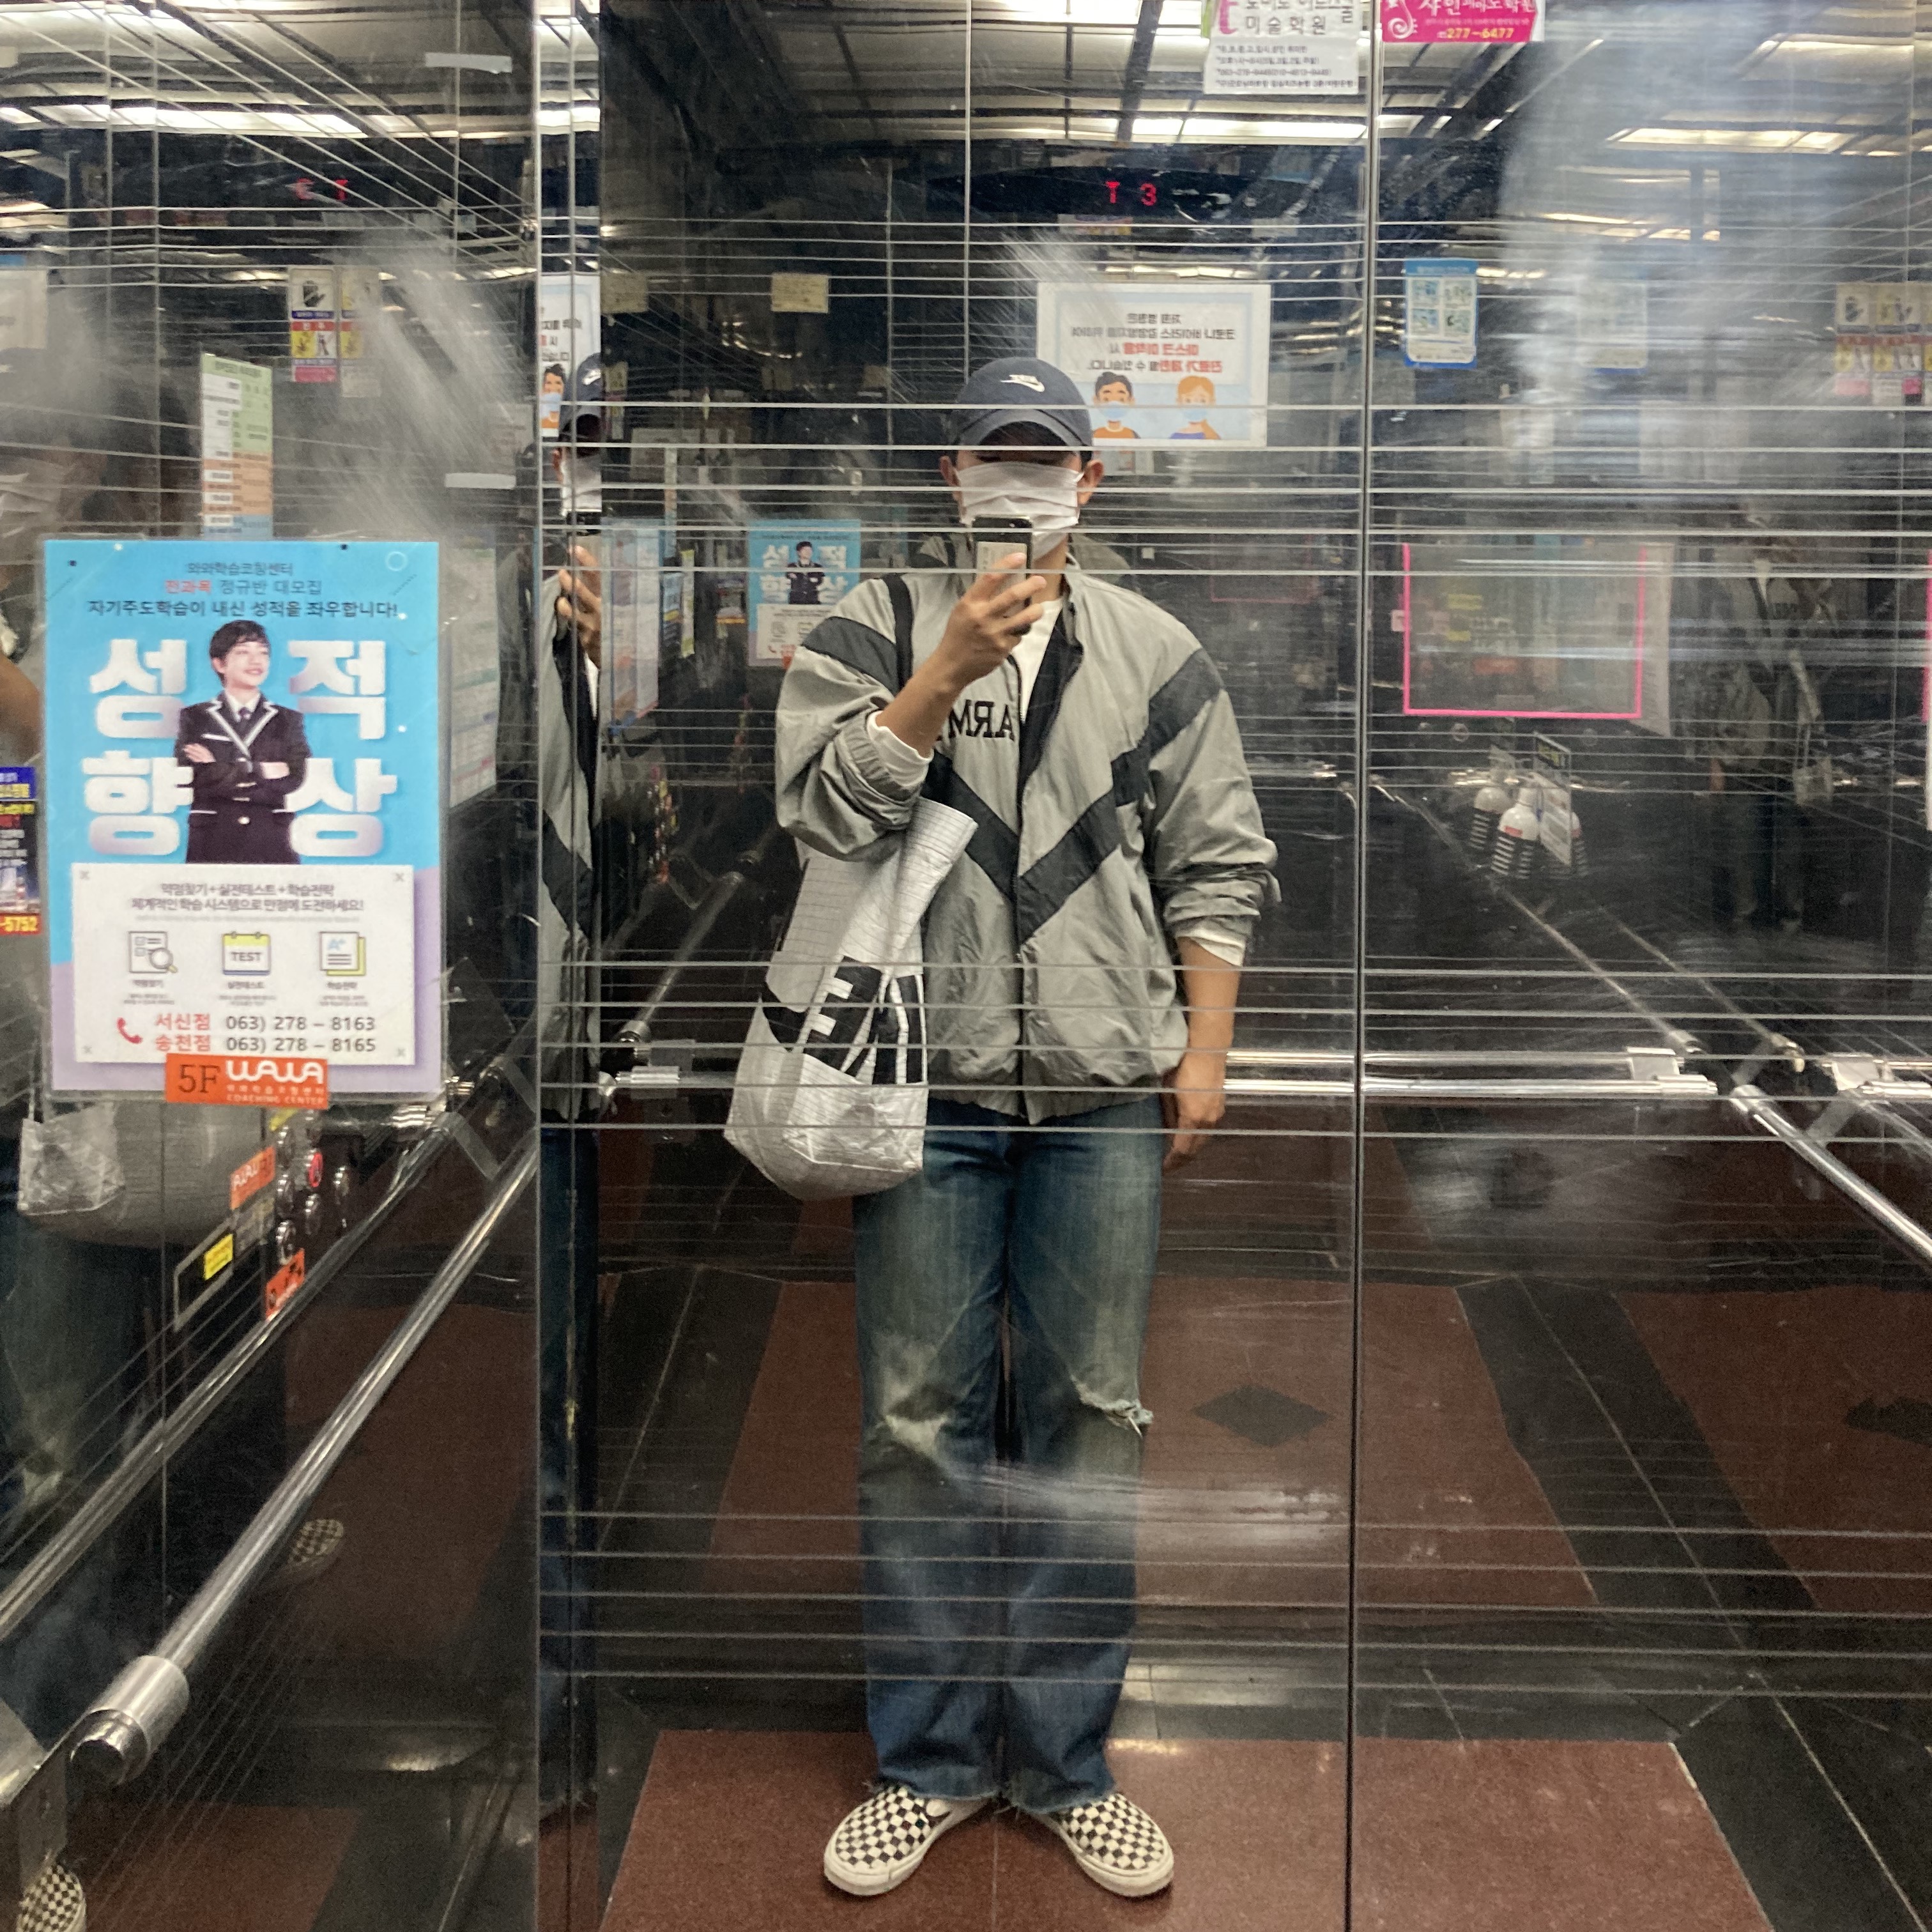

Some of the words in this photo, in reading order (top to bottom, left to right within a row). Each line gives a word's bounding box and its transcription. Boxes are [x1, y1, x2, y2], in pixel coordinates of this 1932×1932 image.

[1245, 15, 1326, 35] 미술학원
[164, 579, 212, 595] 전과목
[220, 579, 269, 595] 정규반
[272, 579, 322, 596] 대모집
[88, 599, 205, 617] 자기주도학습이
[211, 599, 246, 617] 내신
[250, 600, 302, 618] 성적을
[306, 600, 398, 618] 좌우합니다!
[89, 638, 187, 739] 성
[289, 639, 386, 740] 적
[80, 749, 194, 855] 향
[284, 757, 398, 857] 상
[204, 898, 262, 912] 시스템으로
[231, 951, 261, 962] TEST
[155, 1013, 211, 1031] 서신점
[226, 1015, 266, 1032] 063)
[274, 1016, 307, 1030] 278
[331, 1016, 376, 1031] 8163
[155, 1033, 211, 1052] 송천점
[226, 1037, 267, 1054] 063)
[275, 1037, 308, 1052] 278
[331, 1038, 376, 1052] 8165
[178, 1063, 221, 1094] 5F
